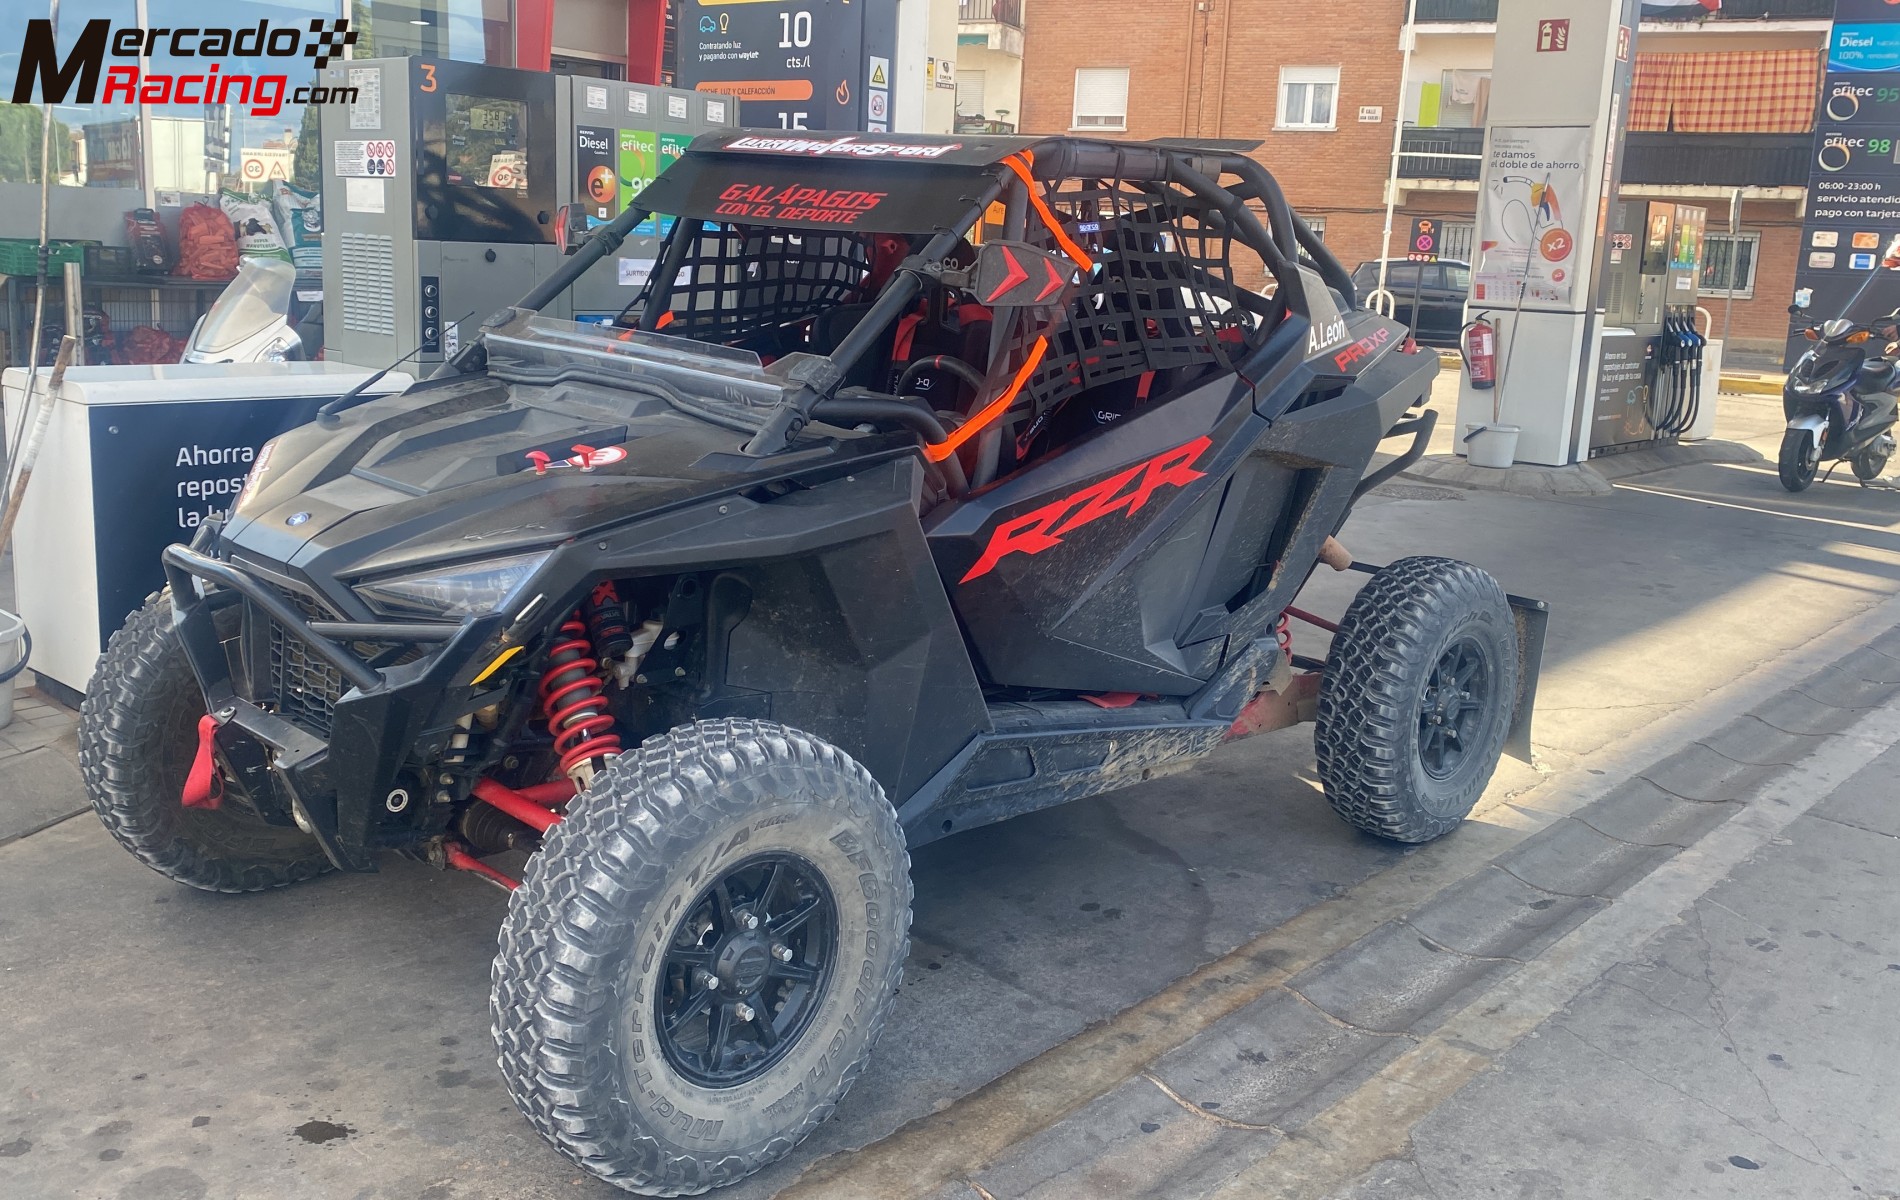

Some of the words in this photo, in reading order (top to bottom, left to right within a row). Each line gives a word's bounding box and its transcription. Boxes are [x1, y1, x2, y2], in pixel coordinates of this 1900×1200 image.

[779, 11, 812, 48] 10
[699, 42, 733, 50] Contratando
[1840, 36, 1874, 47] Diesel
[703, 53, 727, 61] pagando
[786, 55, 811, 68] cts./l
[1839, 51, 1864, 59] 100%
[420, 64, 437, 93] 3
[737, 87, 776, 95] CALEFACCIÓN
[1832, 86, 1874, 96] efitec
[1876, 88, 1900, 102] 95
[579, 135, 608, 150] Diesel
[621, 139, 655, 153] efitec
[1824, 136, 1865, 147] efitec
[1867, 138, 1892, 153] 98
[1501, 150, 1536, 159] damos
[1490, 160, 1498, 168] el
[1499, 160, 1528, 169] doble
[1530, 160, 1544, 169] de
[1545, 160, 1580, 169] ahorro
[1818, 182, 1873, 190] 06:00-23:00
[719, 183, 888, 210] GALÁPAGOS
[1816, 194, 1858, 203] servicio
[715, 203, 754, 215] CON
[752, 205, 773, 217] EL
[776, 207, 863, 223] DEPORTE
[1814, 209, 1842, 218] pago
[1547, 237, 1566, 252] x2
[625, 269, 650, 277] SURTIDO
[1308, 315, 1346, 354] A.León
[176, 445, 254, 467] Ahorra
[958, 435, 1213, 585] RZR
[178, 507, 200, 528] la
